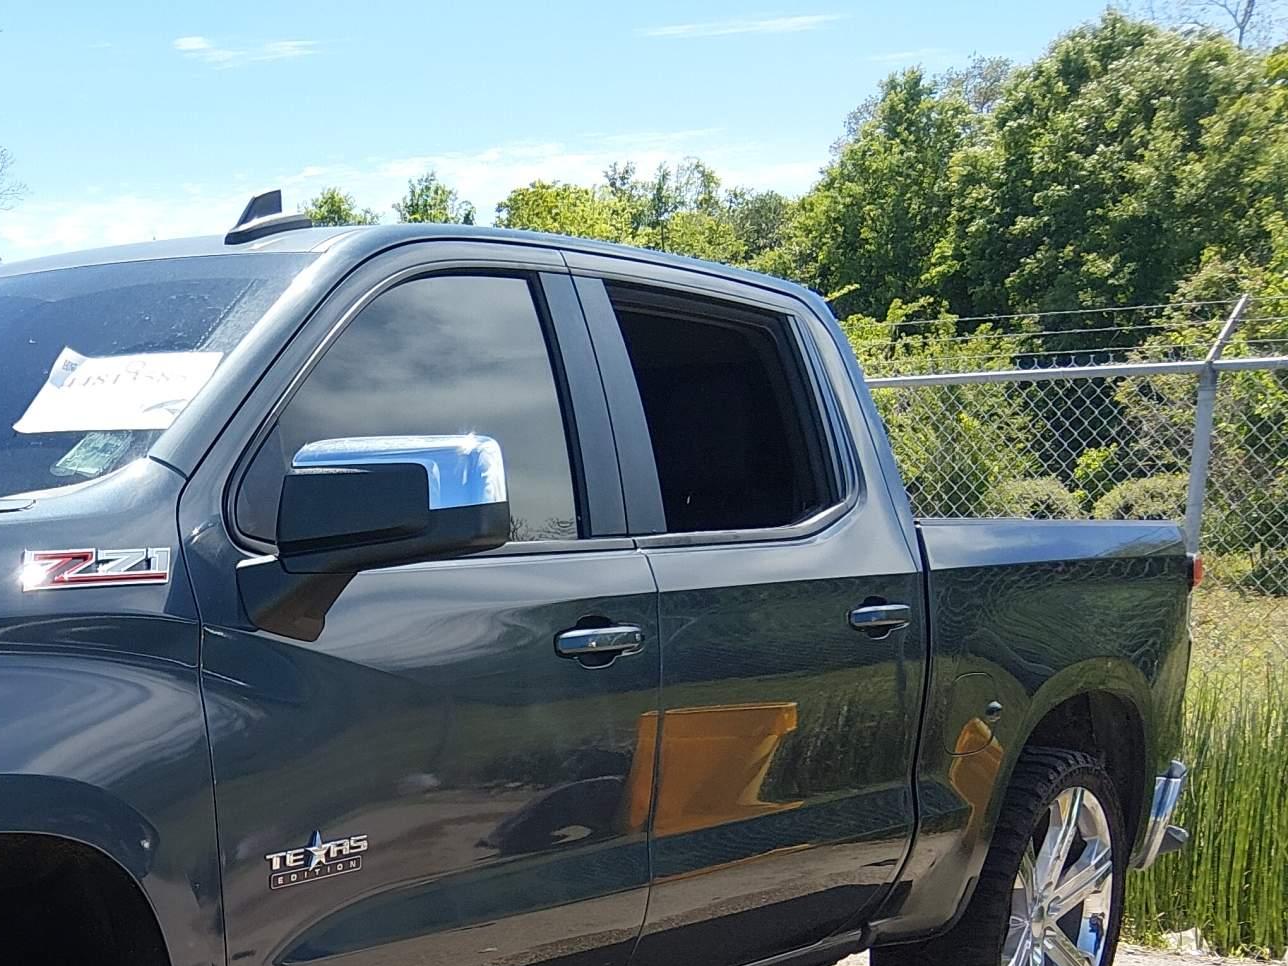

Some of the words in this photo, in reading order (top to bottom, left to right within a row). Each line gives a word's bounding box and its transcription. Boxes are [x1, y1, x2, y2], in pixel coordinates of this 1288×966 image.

[22, 548, 171, 592] Z71
[266, 830, 368, 871] TEXAS
[277, 859, 357, 885] EDITION
